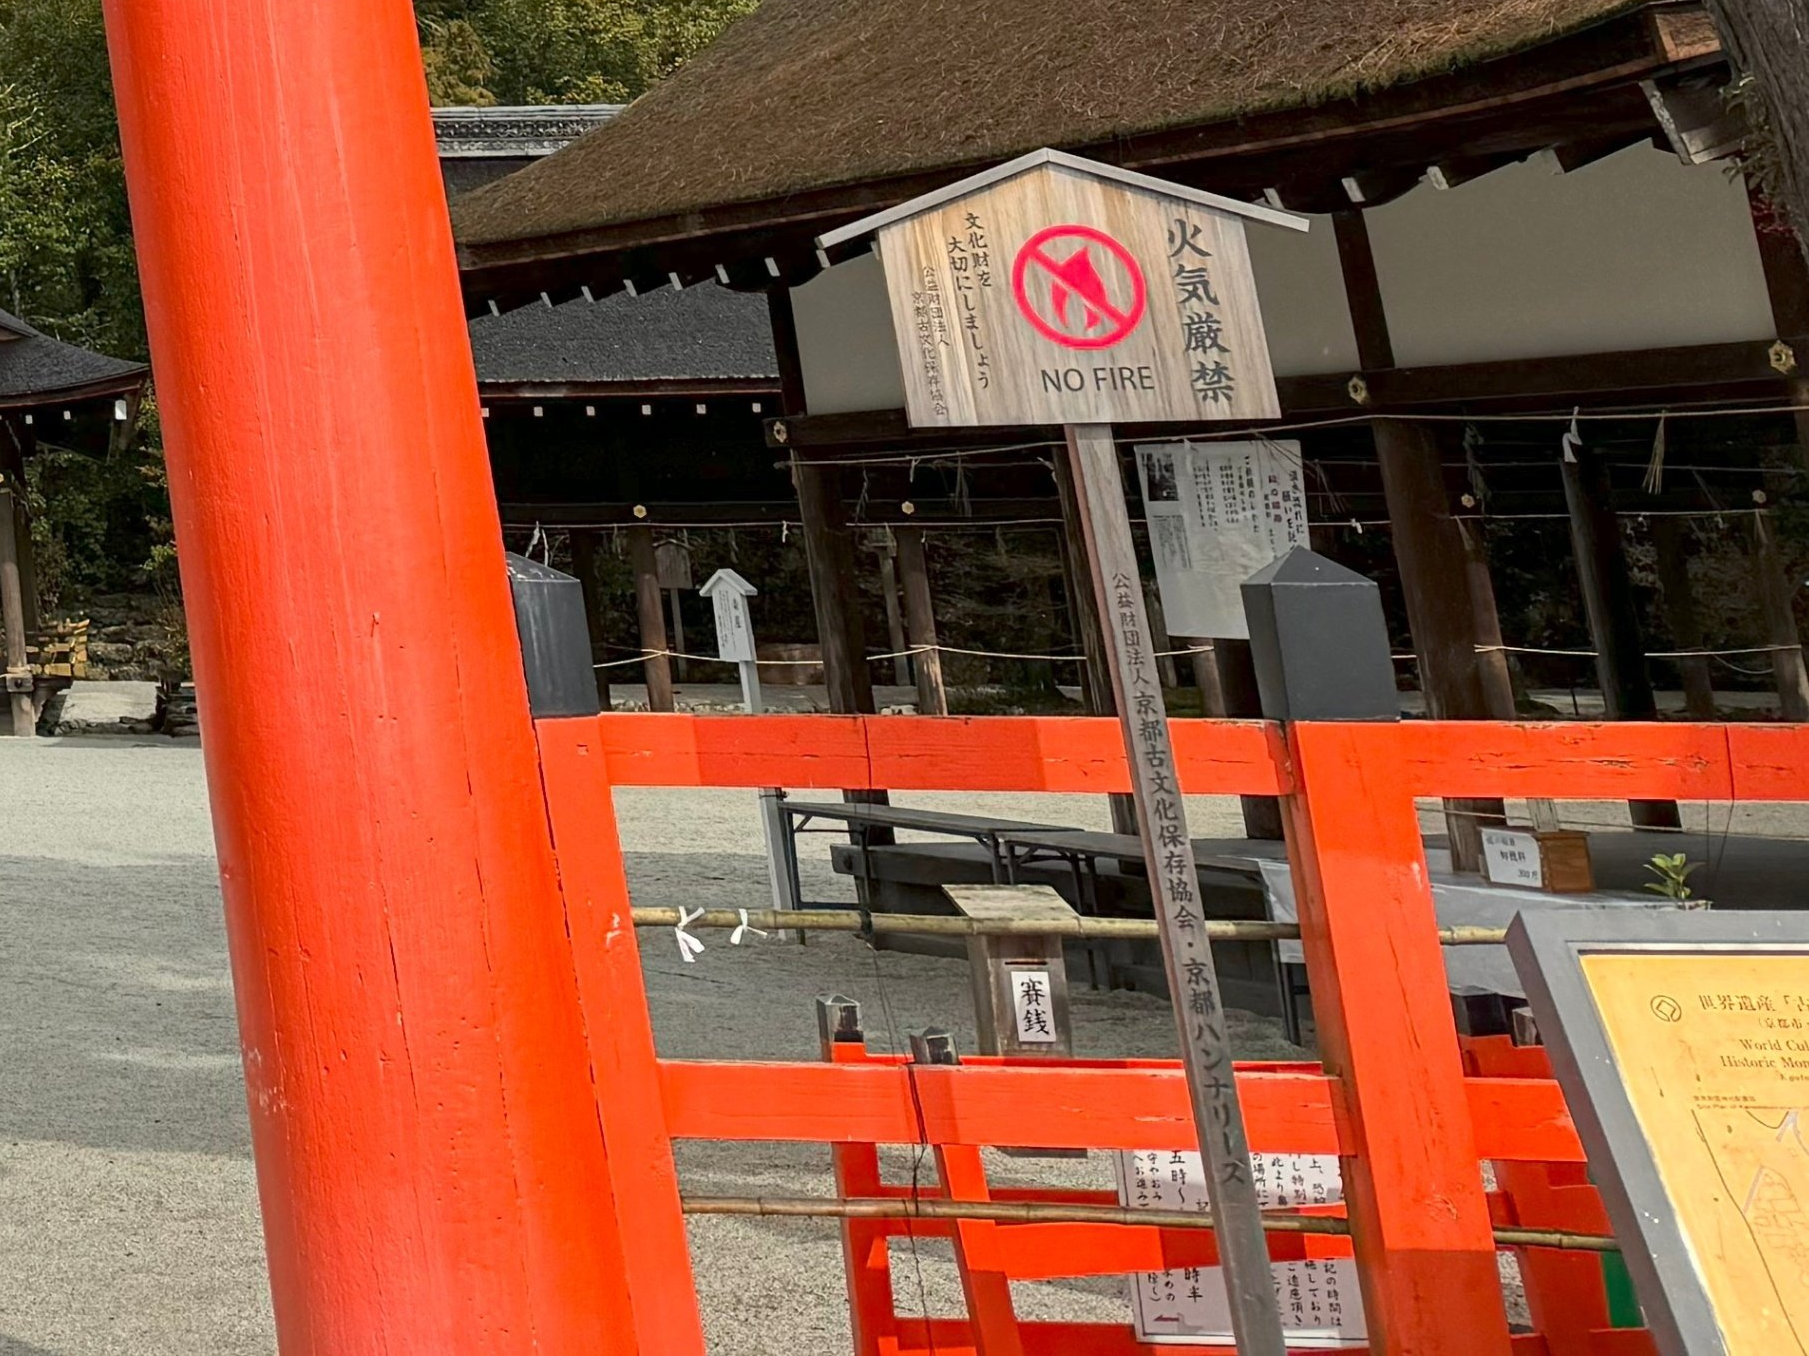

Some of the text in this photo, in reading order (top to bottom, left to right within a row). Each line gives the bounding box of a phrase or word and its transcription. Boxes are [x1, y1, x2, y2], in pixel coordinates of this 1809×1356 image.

[965, 212, 992, 288] 文化財を
[948, 236, 990, 390] 大切にしましょう
[1167, 218, 1235, 404] 火気厳禁
[1040, 366, 1155, 393] NO FIRE
[1020, 978, 1050, 1036] 賽銭
[1719, 1055, 1777, 1068] Historic
[1739, 1039, 1782, 1051] World
